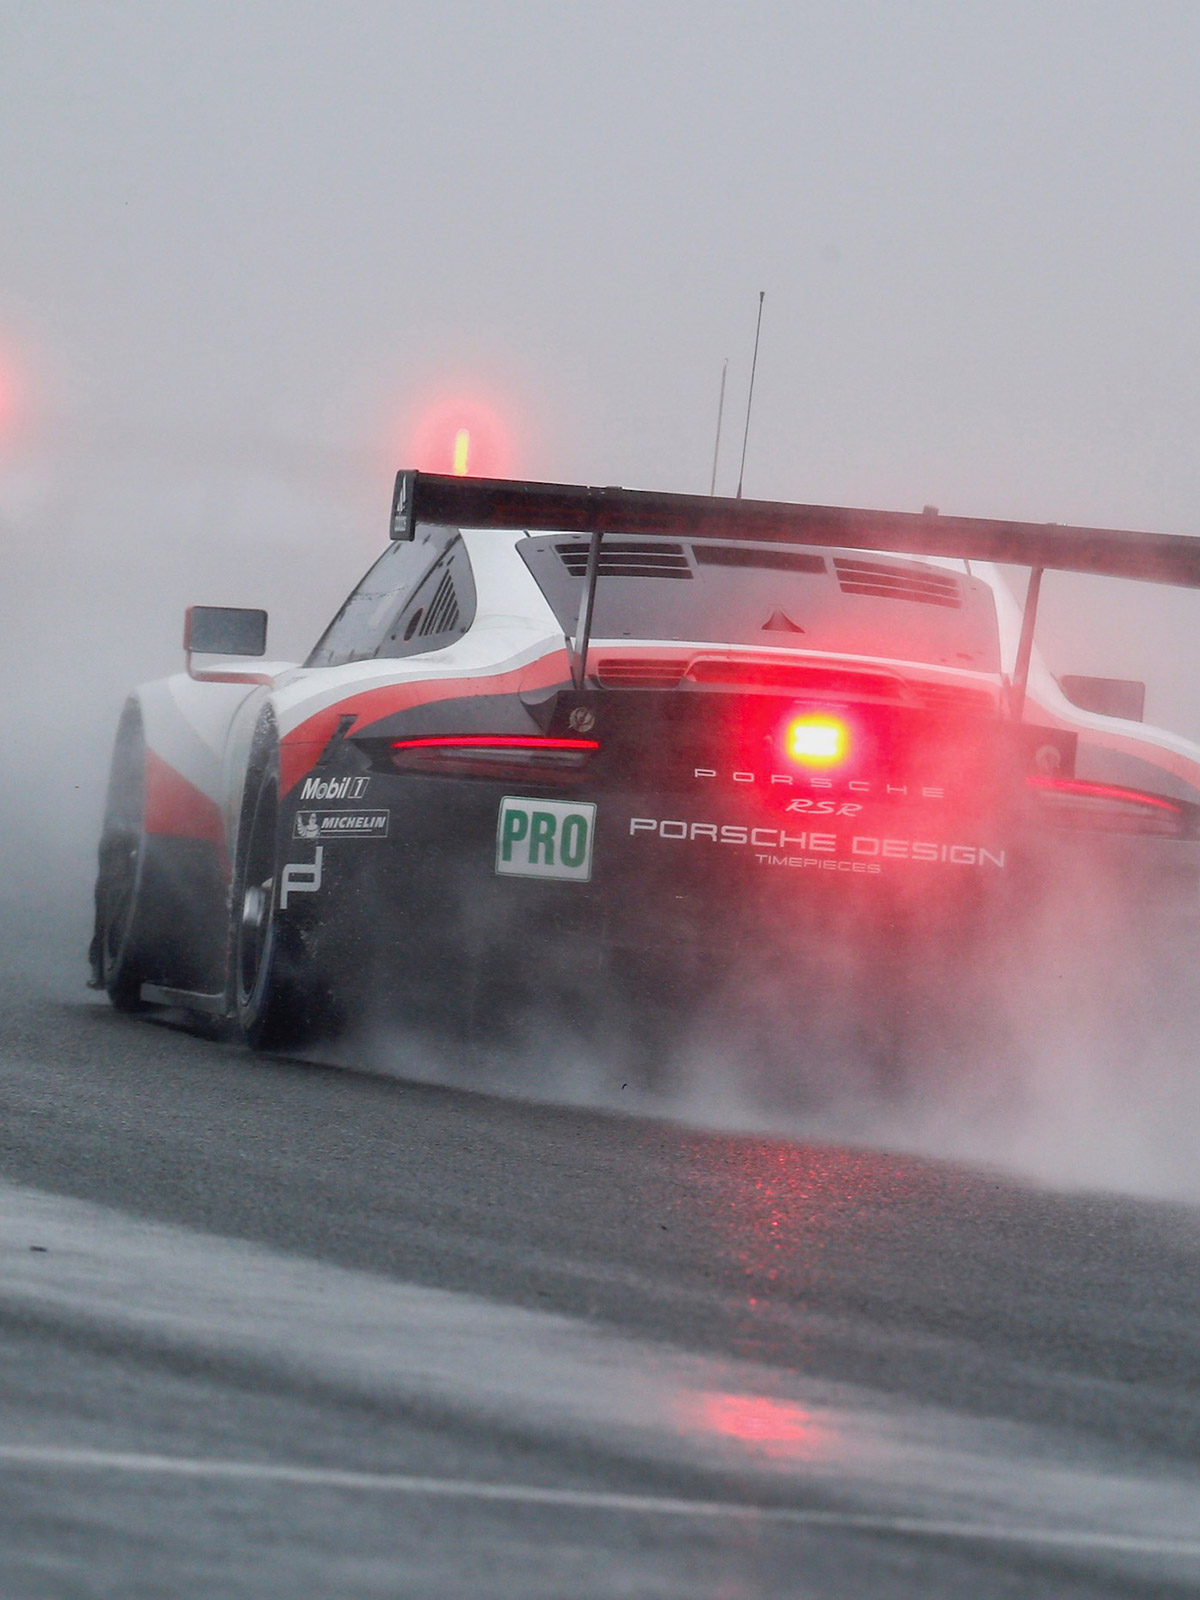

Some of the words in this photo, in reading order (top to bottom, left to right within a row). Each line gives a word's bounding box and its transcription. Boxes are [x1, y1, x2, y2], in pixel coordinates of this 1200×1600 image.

[301, 777, 351, 800] Mobil
[694, 768, 944, 798] PORSCHE
[785, 799, 863, 817] RSR
[321, 815, 386, 830] MICHELIN
[501, 809, 588, 869] PRO
[629, 818, 836, 852] PORSCHE
[852, 836, 1006, 868] DESIGN
[755, 854, 882, 874] TIMEPIECES
